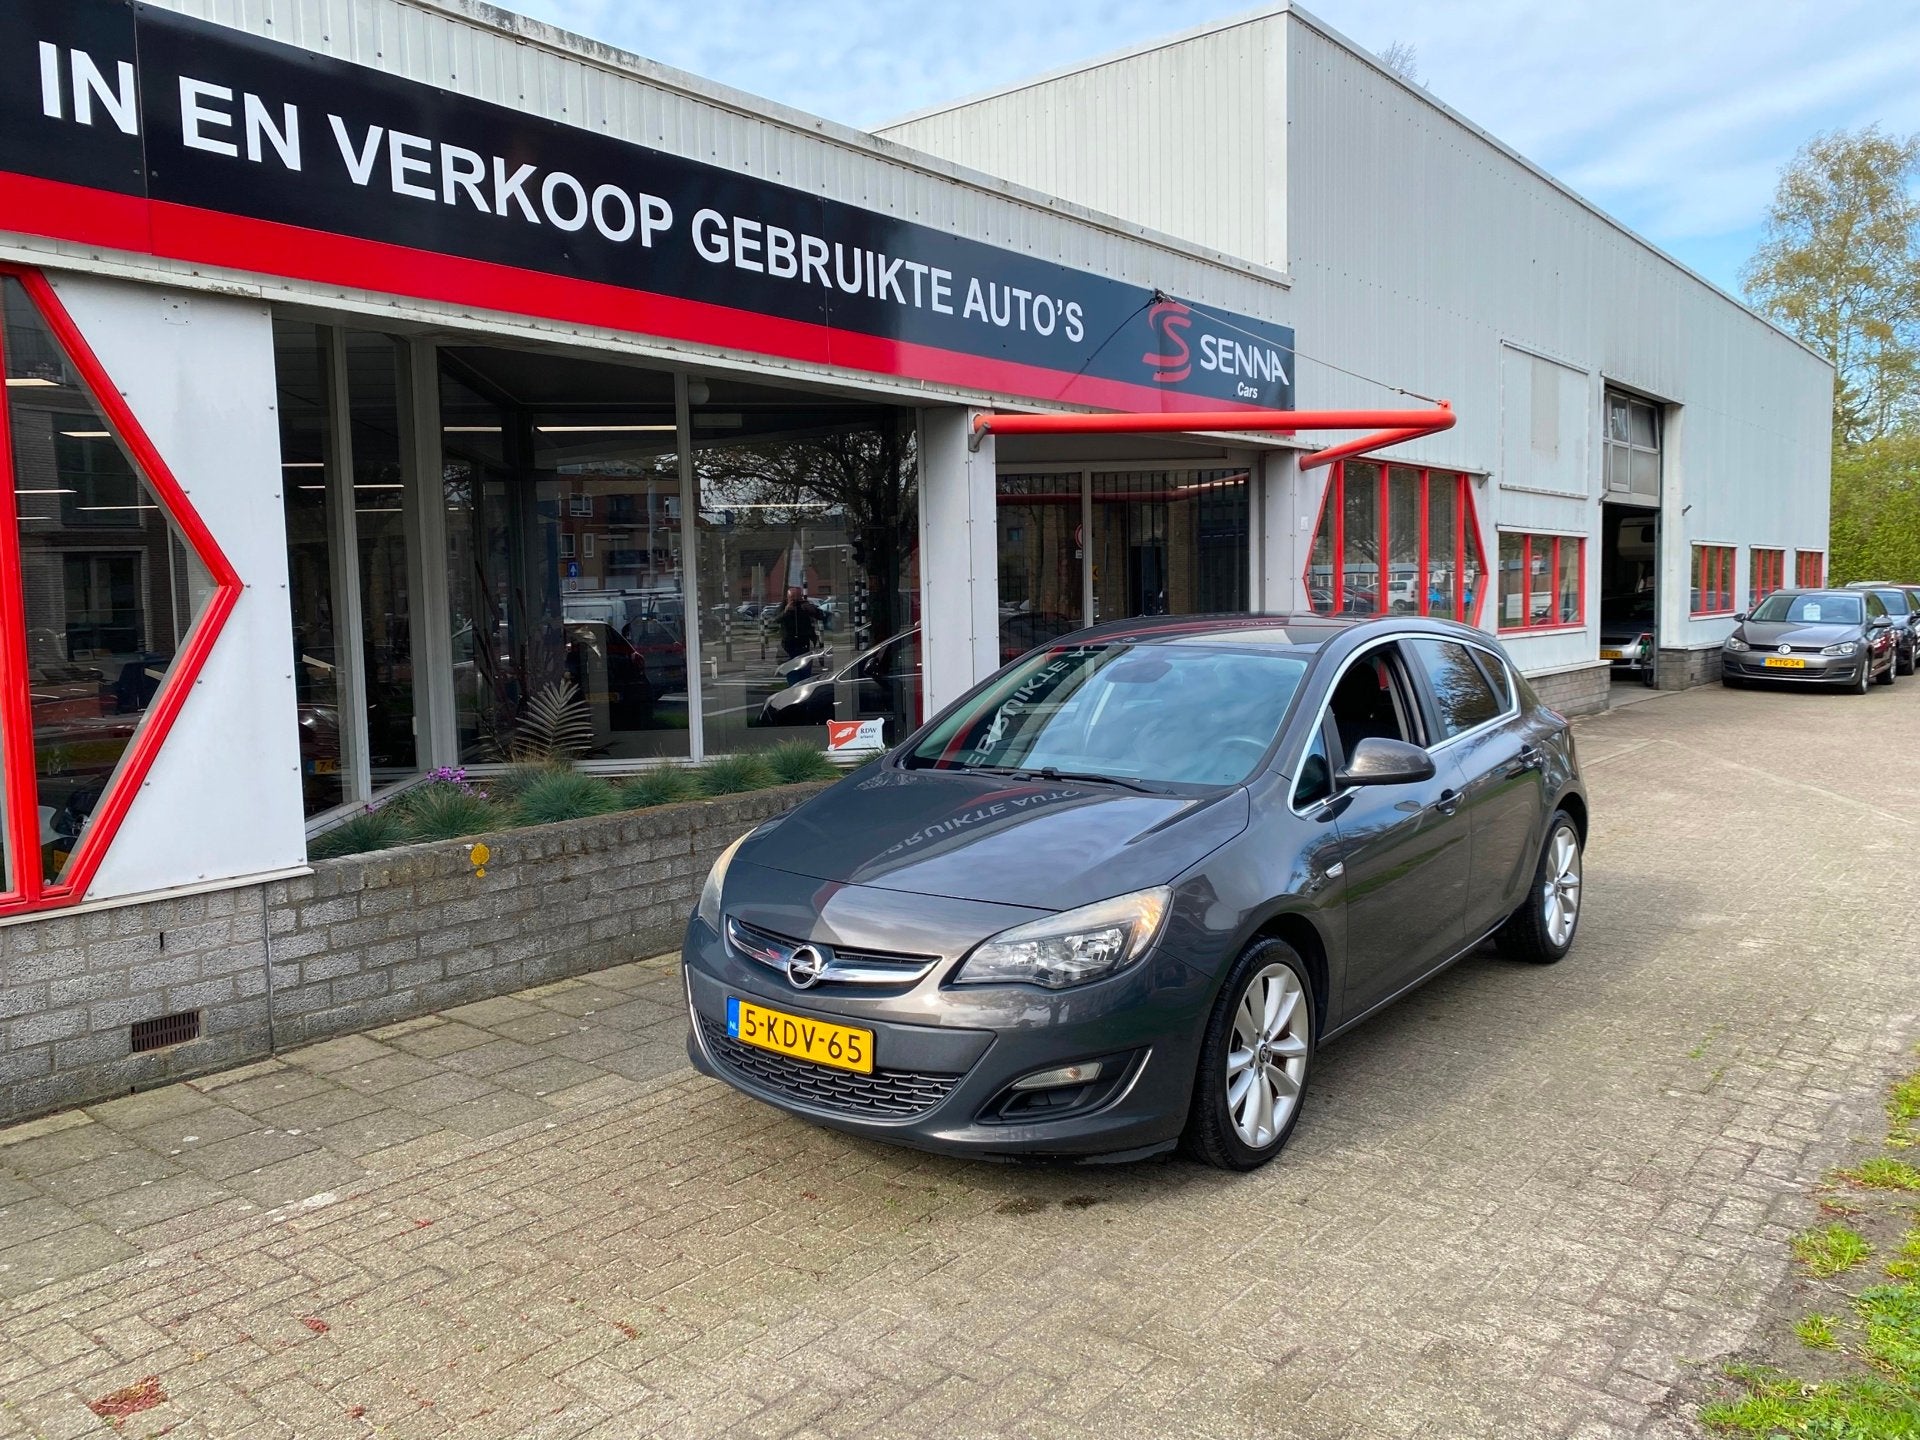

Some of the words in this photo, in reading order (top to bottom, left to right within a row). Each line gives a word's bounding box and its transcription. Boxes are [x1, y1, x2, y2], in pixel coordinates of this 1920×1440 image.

[38, 41, 138, 136] IN
[178, 75, 302, 172] EN
[327, 113, 673, 248] VERKOOP
[691, 208, 954, 315] GEBRUIKTE
[962, 277, 1084, 343] AUTO'S
[1200, 334, 1290, 386] SENNA
[1237, 381, 1259, 399] Cars
[745, 1008, 862, 1064] 5-KDV-65
